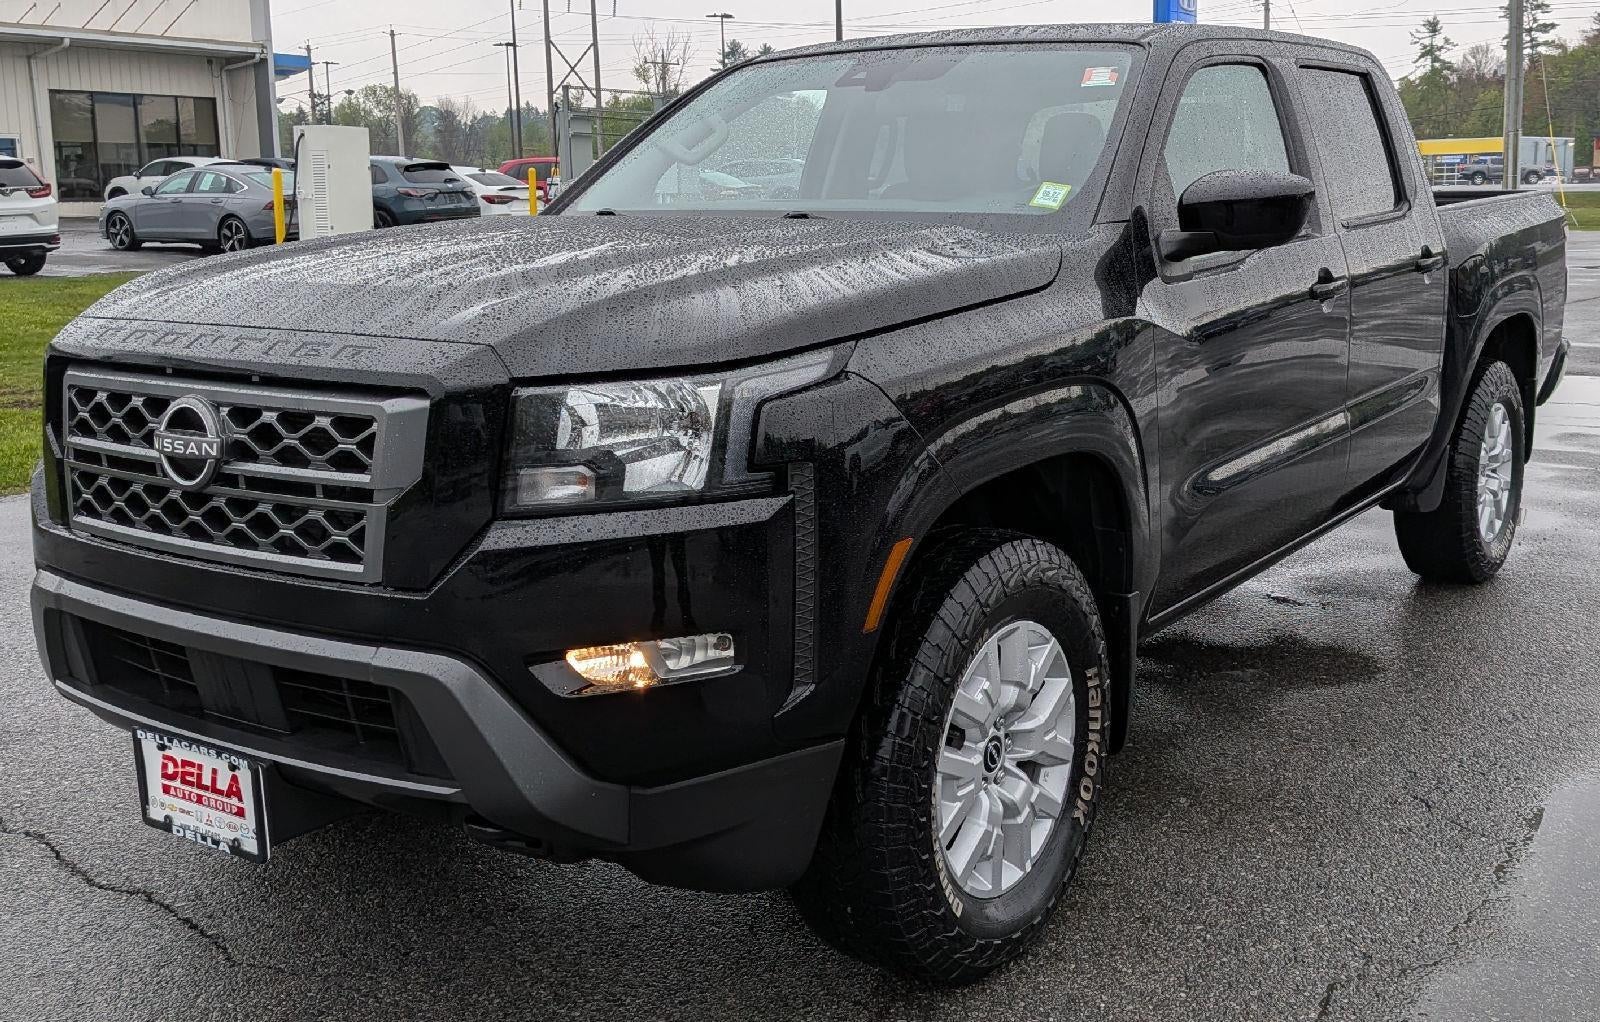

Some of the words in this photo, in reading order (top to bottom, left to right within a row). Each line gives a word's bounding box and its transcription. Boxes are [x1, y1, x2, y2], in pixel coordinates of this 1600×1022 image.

[154, 436, 217, 456] NISSAN
[136, 729, 249, 768] DELLACARS.COM
[1072, 666, 1102, 826] Hankook
[160, 753, 244, 803] DELLA
[169, 786, 198, 802] AUTO
[202, 796, 238, 814] GROUP
[172, 825, 231, 854] DELLA
